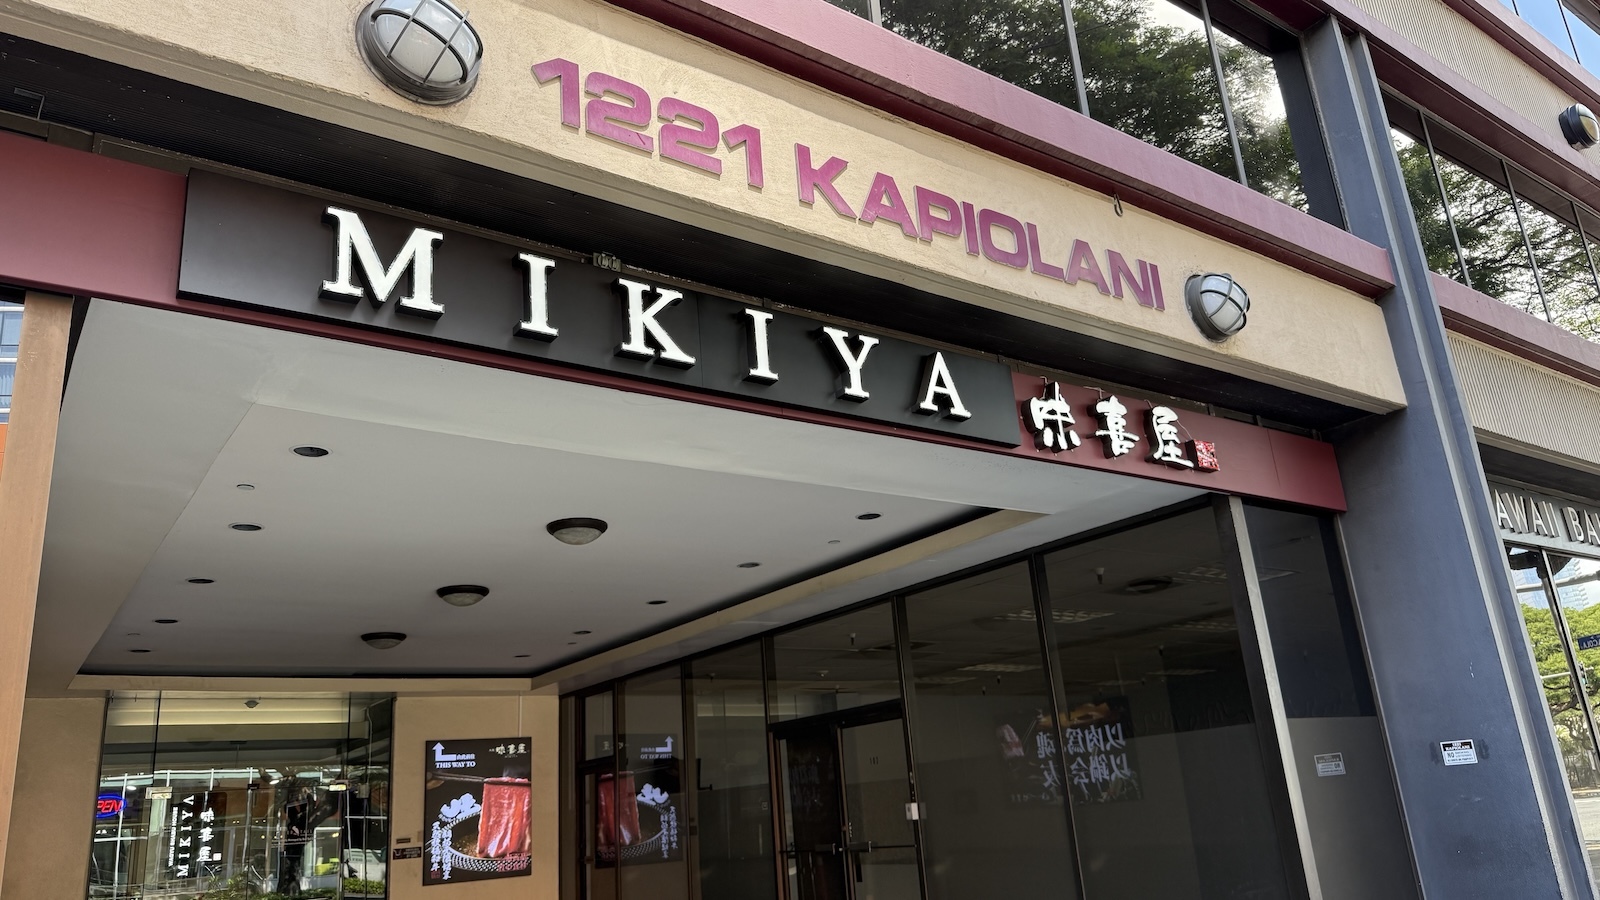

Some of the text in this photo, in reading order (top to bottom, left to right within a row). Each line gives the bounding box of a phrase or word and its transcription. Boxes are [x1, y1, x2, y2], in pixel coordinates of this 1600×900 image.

[531, 57, 1165, 311] 1221 KAPIOLANI
[320, 205, 972, 421] MIKIYA
[1023, 381, 1195, 470] 味喜屋
[177, 795, 195, 878] MIKIYA
